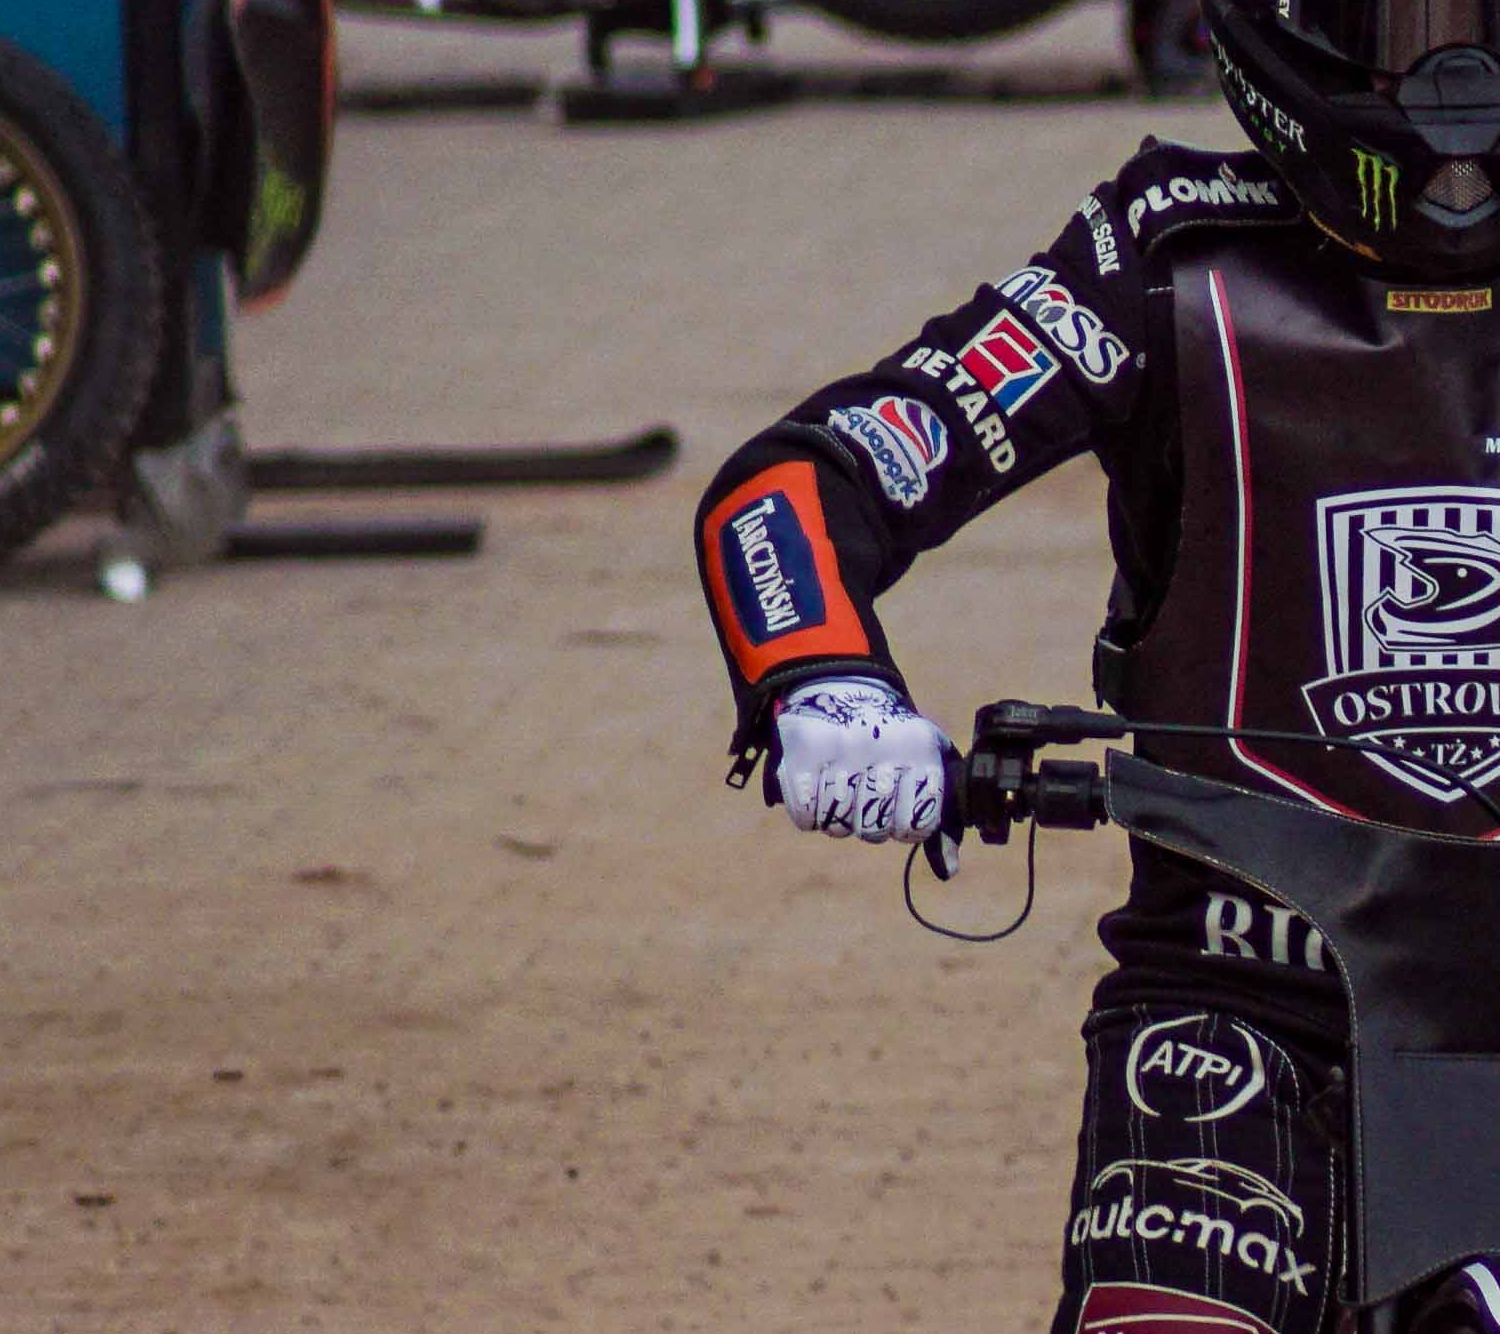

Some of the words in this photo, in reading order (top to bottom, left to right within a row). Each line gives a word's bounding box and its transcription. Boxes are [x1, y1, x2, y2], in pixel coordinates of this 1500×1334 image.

[1391, 289, 1490, 309] SITODRUK
[902, 345, 1017, 475] BETARD
[1430, 738, 1468, 766] TŻ
[1199, 890, 1332, 972] RI
[1141, 1036, 1249, 1089] ATPI
